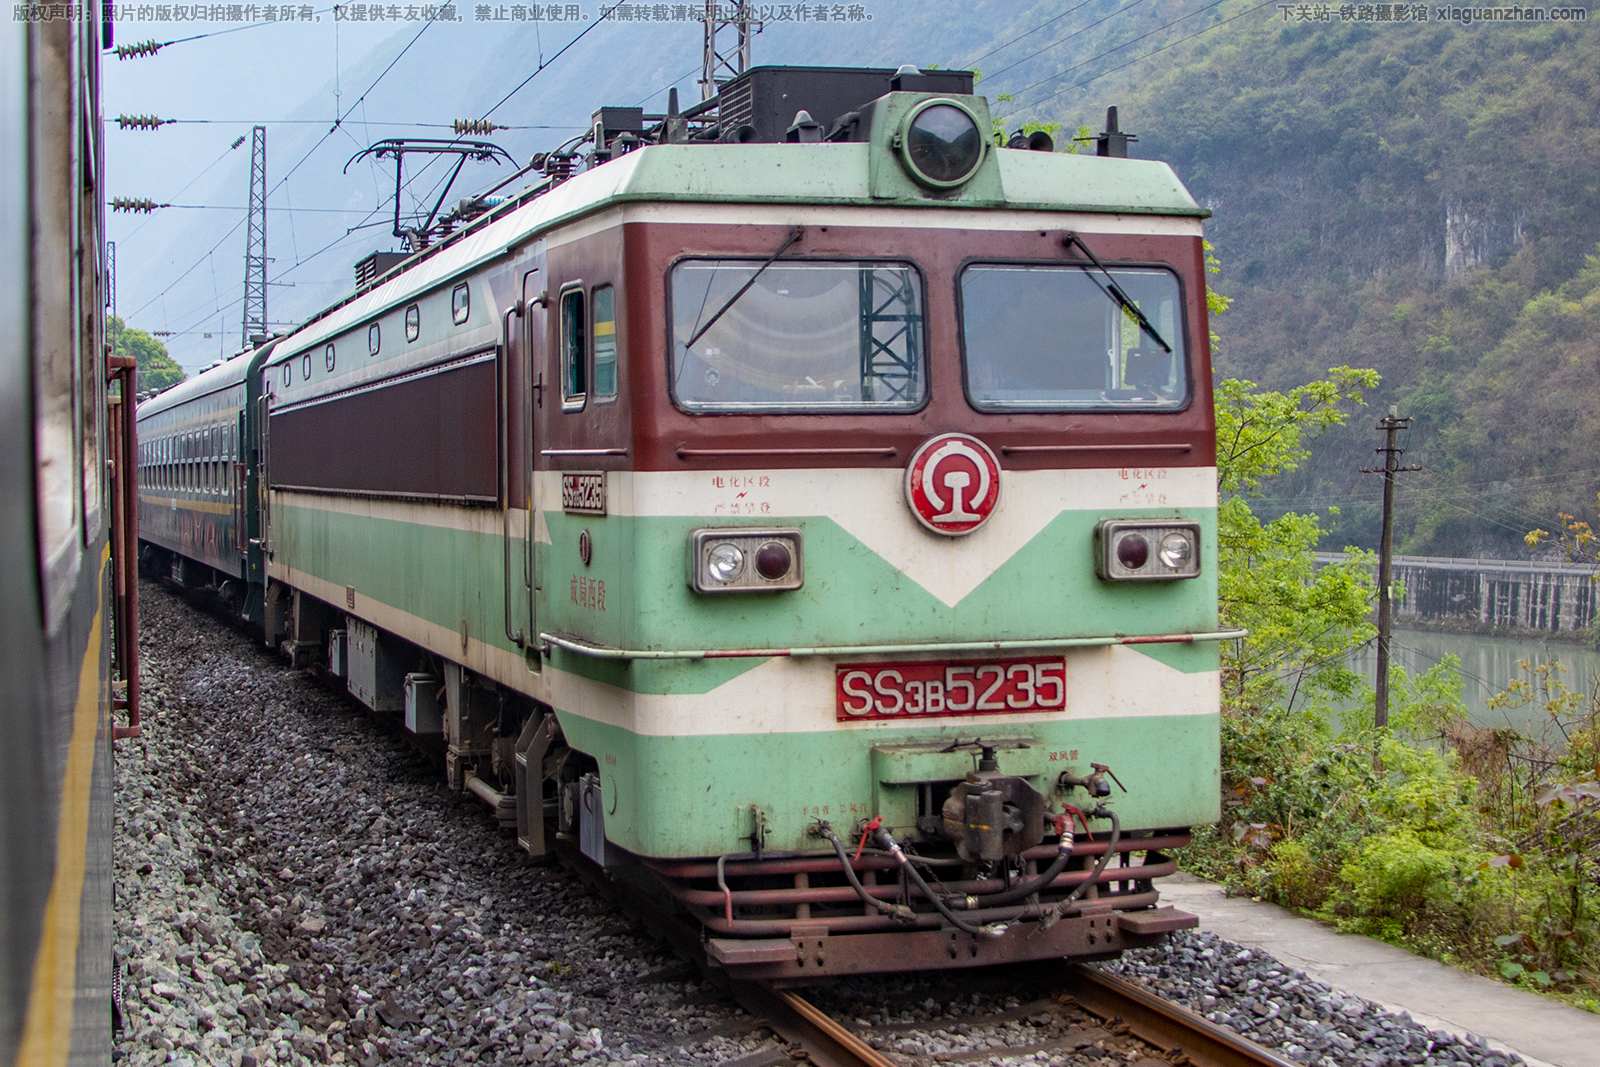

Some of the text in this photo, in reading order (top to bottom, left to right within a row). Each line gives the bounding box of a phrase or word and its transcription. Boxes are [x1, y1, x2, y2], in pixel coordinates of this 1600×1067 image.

[570, 574, 606, 612] 成局西段
[842, 662, 1064, 716] SS3B5235
[1049, 749, 1078, 761] 双风管
